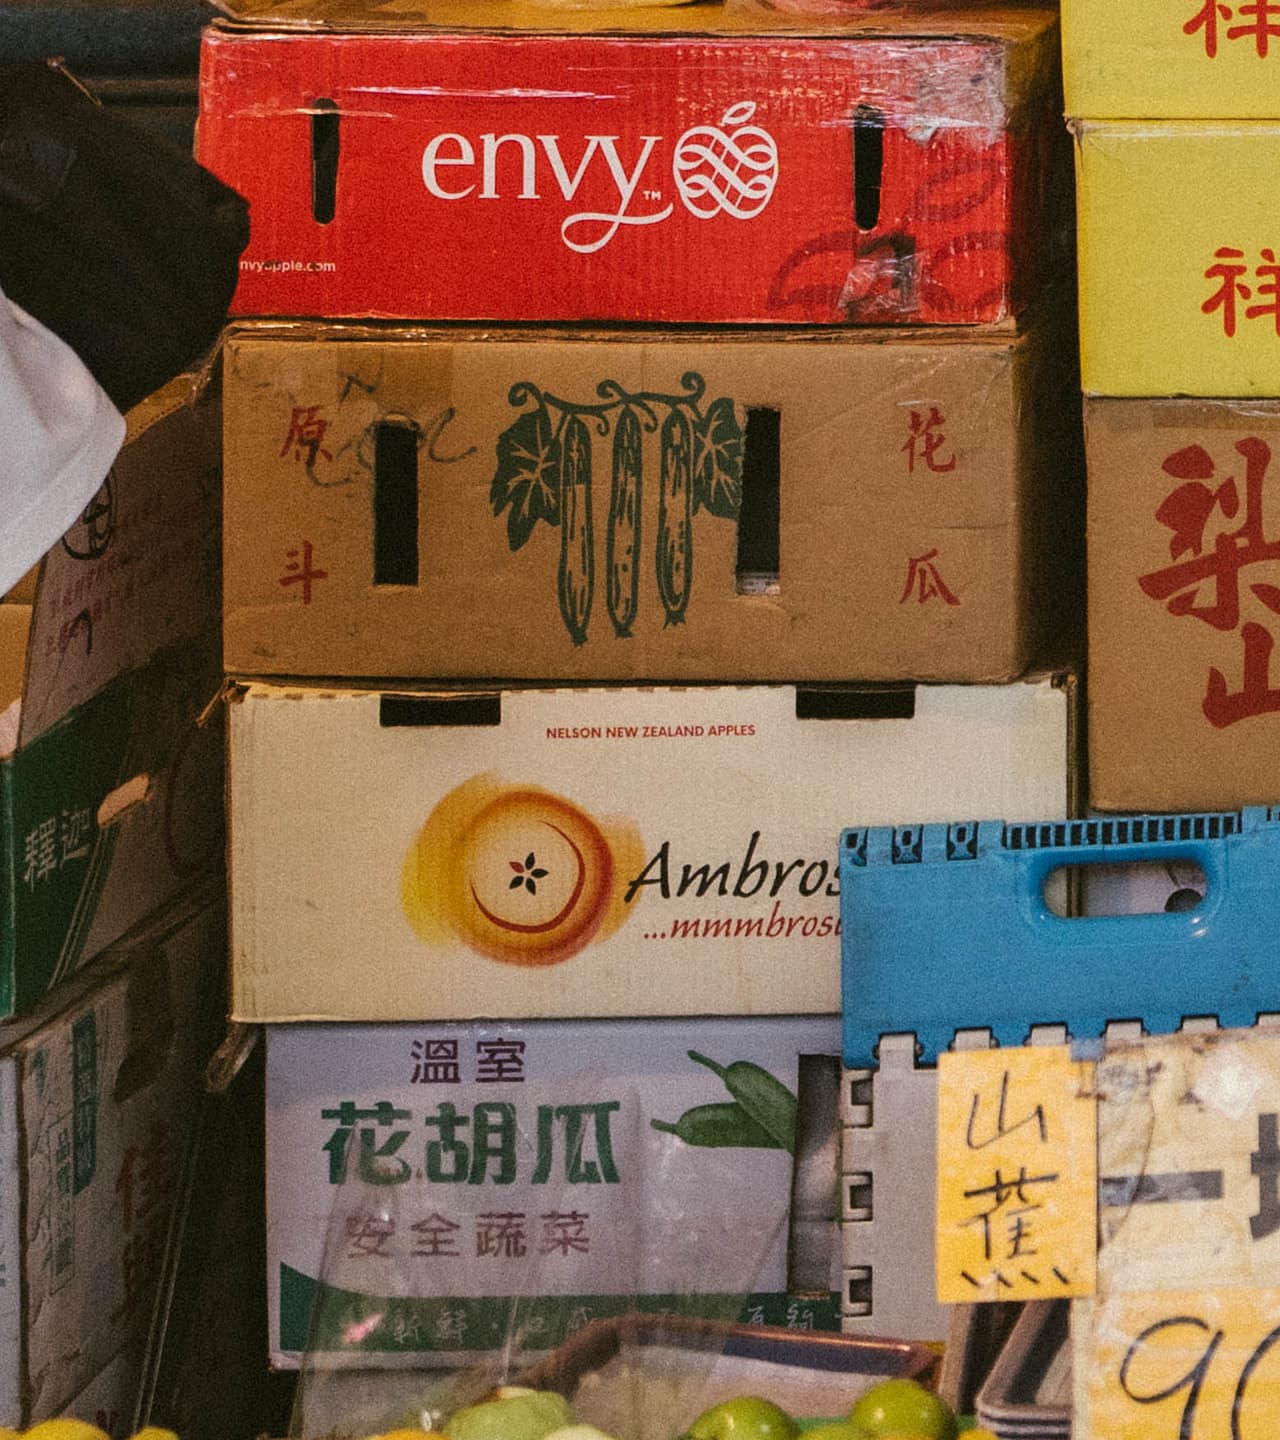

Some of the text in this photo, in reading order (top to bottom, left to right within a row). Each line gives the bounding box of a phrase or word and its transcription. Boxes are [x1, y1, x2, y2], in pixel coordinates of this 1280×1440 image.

[422, 132, 674, 254] envy
[239, 259, 336, 273] nvyapple.com
[898, 407, 962, 609] 花瓜
[546, 724, 756, 740] NELSON NEW ZEALAND APPLES
[409, 1037, 528, 1088] 溫室
[320, 1100, 622, 1186] 花胡瓜
[960, 1069, 1071, 1288] 山蕉
[345, 1211, 591, 1263] 安全蔬菜
